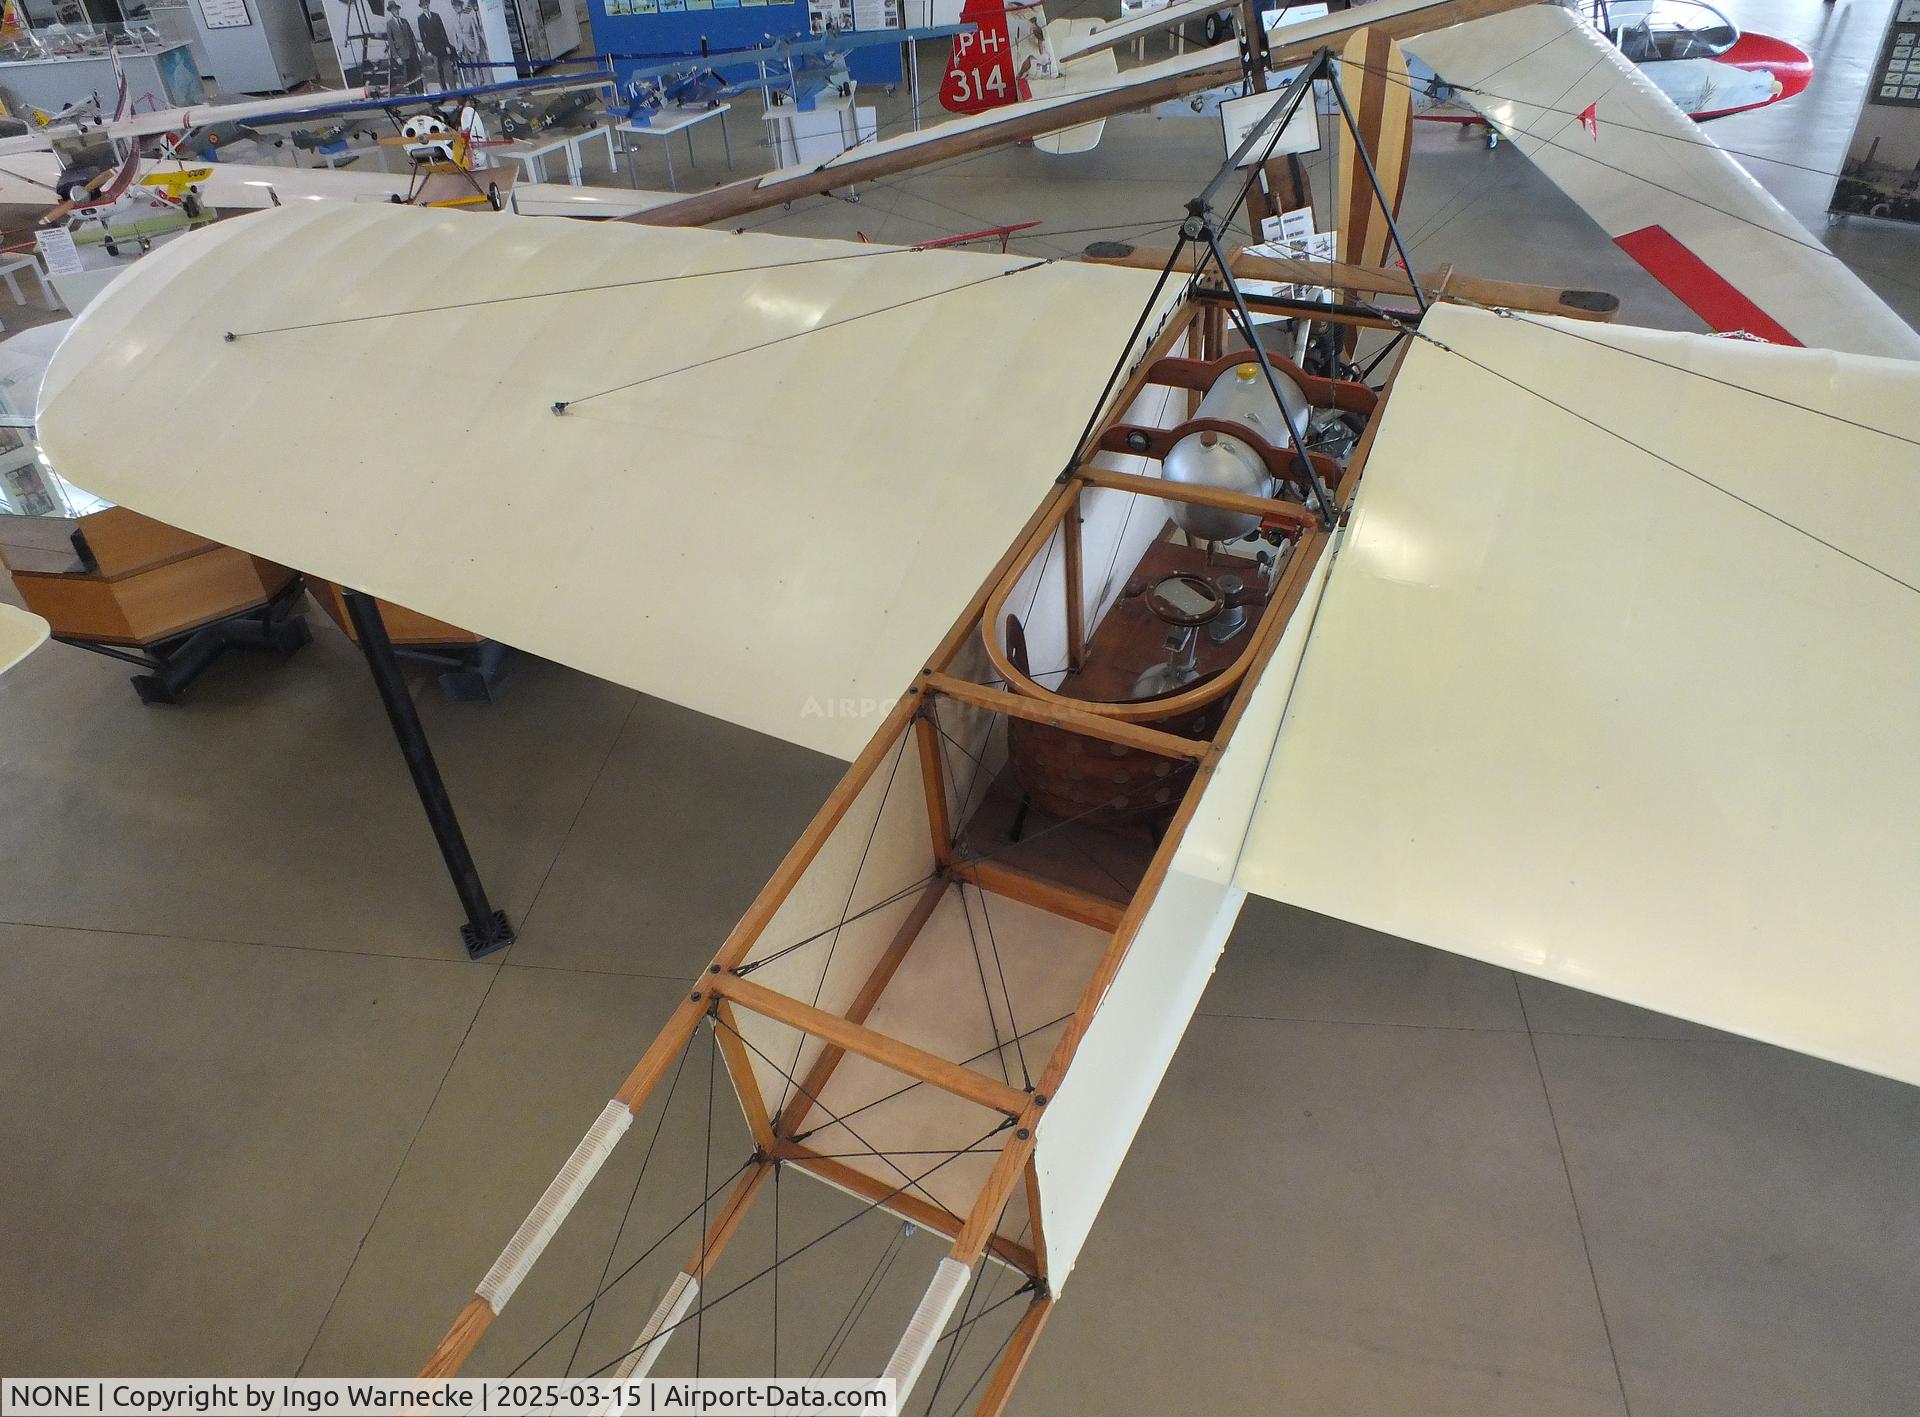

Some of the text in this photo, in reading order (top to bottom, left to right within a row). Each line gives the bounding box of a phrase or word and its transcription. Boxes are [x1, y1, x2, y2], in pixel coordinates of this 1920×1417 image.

[960, 28, 1006, 57] PH-
[950, 64, 1007, 102] 314
[504, 118, 515, 132] S
